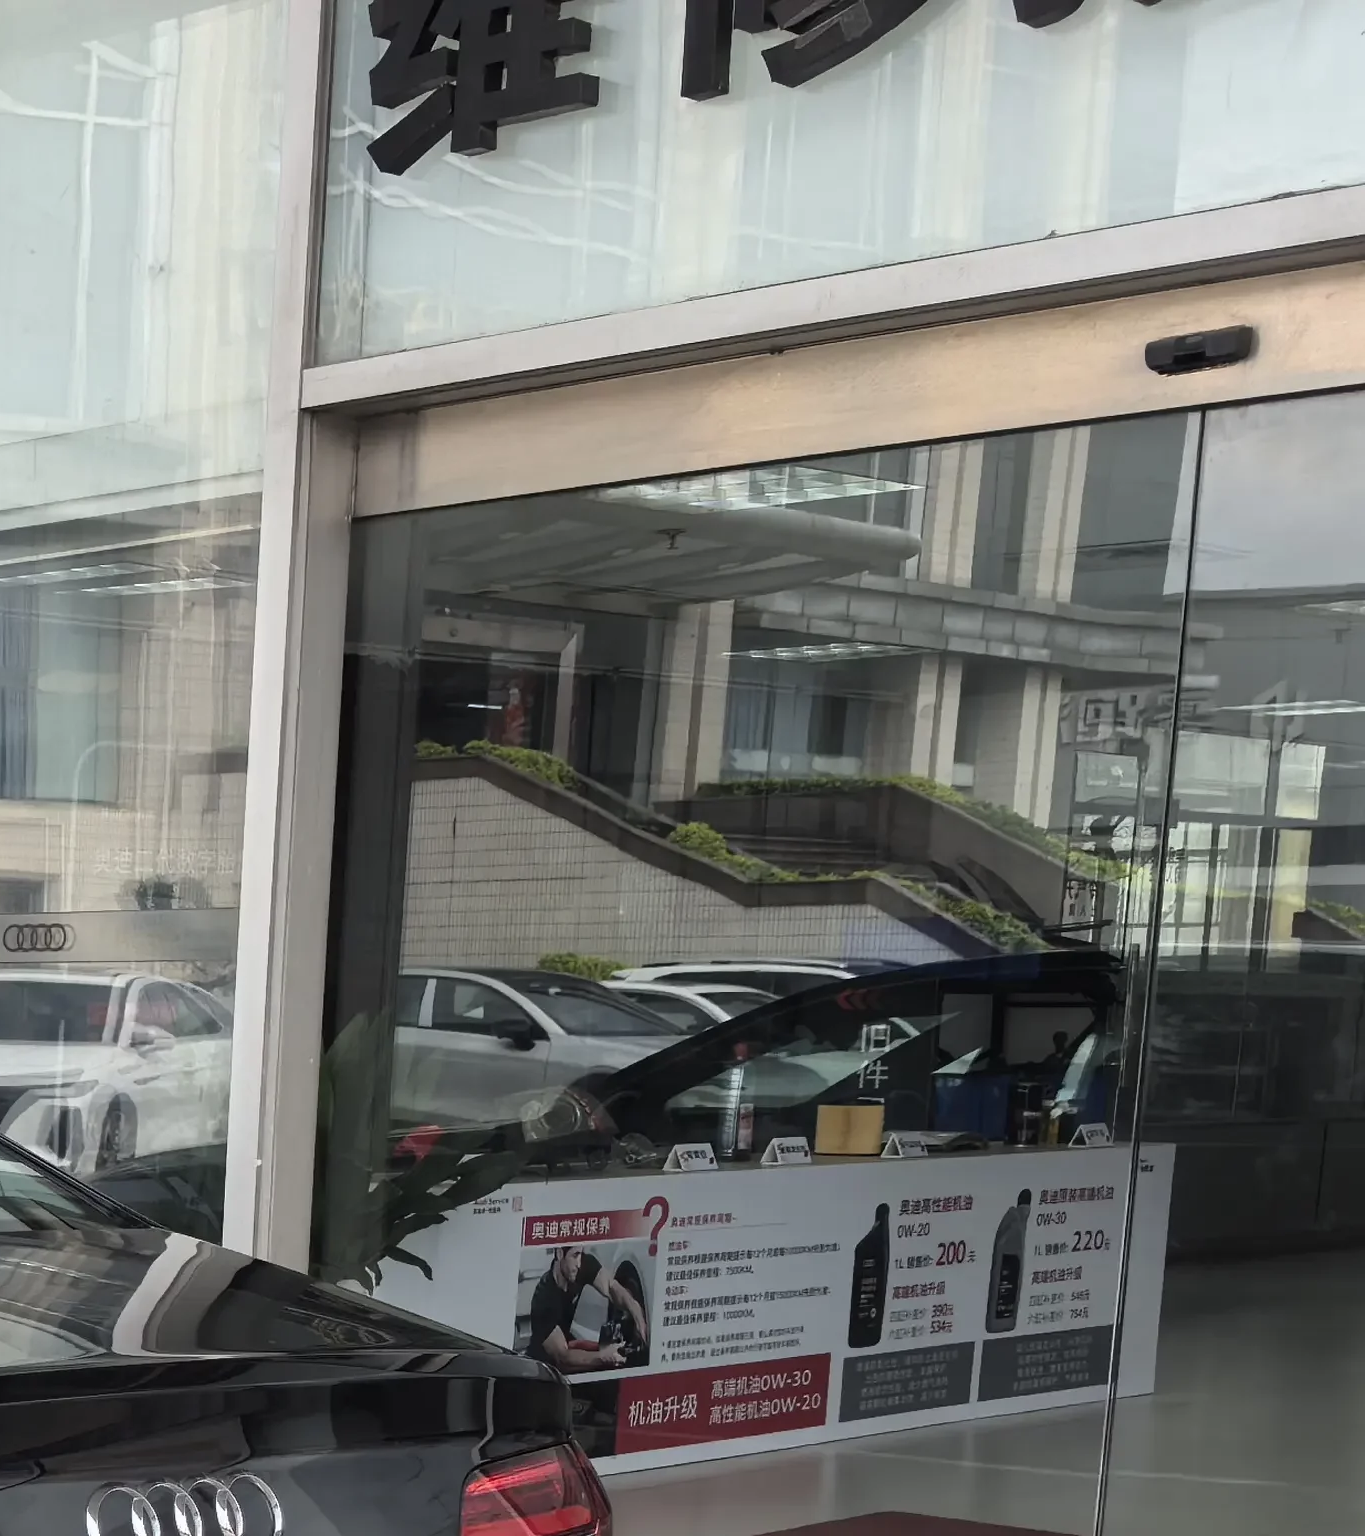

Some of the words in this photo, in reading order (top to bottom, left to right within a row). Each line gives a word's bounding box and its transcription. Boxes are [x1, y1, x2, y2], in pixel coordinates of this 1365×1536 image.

[857, 1023, 891, 1104] 旧件
[532, 1216, 611, 1240] 奥迪常规保养
[711, 1369, 812, 1400] 高端机油0W-30
[628, 1393, 698, 1427] 机油升级
[709, 1393, 821, 1426] 高性能机油0W-20
